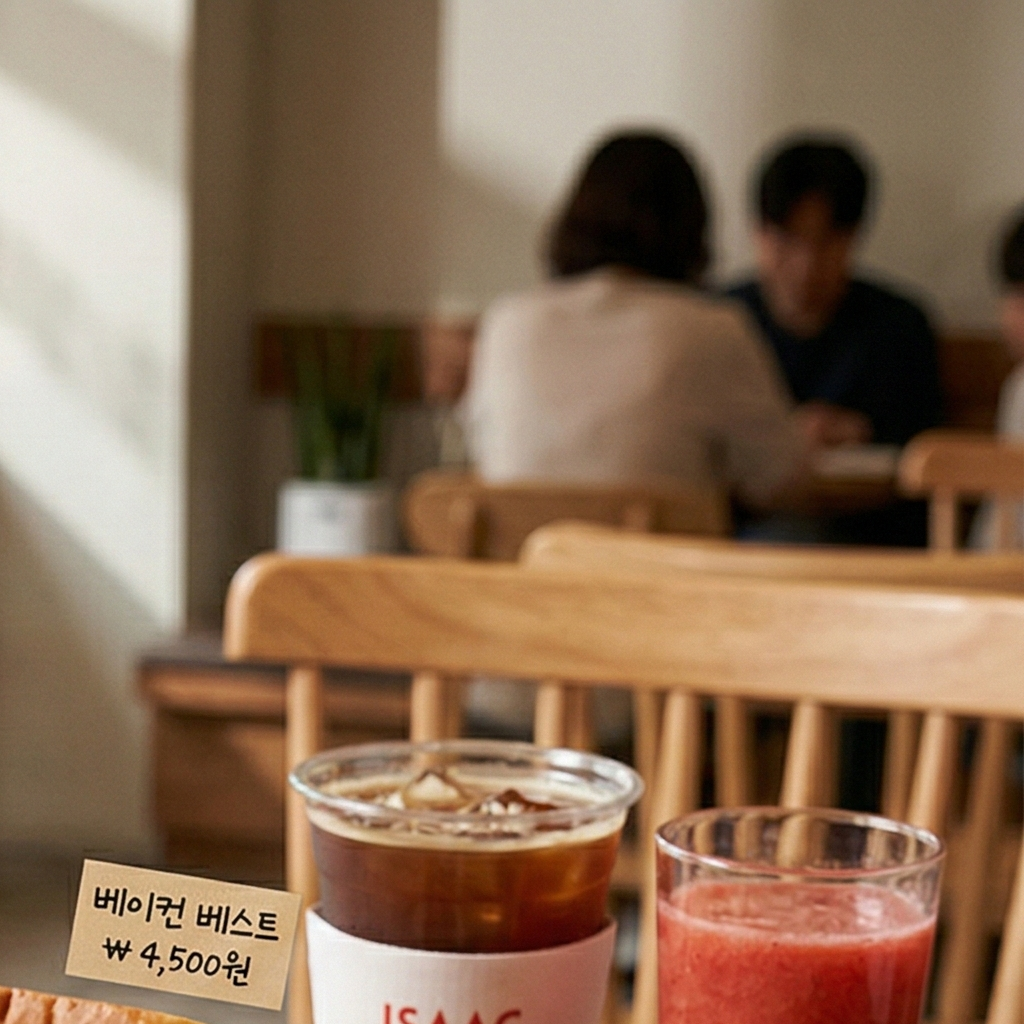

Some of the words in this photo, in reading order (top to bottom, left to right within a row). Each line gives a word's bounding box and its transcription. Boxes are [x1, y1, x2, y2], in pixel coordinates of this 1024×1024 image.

[93, 886, 186, 929] 베이컨
[196, 903, 280, 942] 베스트
[139, 941, 252, 987] 4,500원
